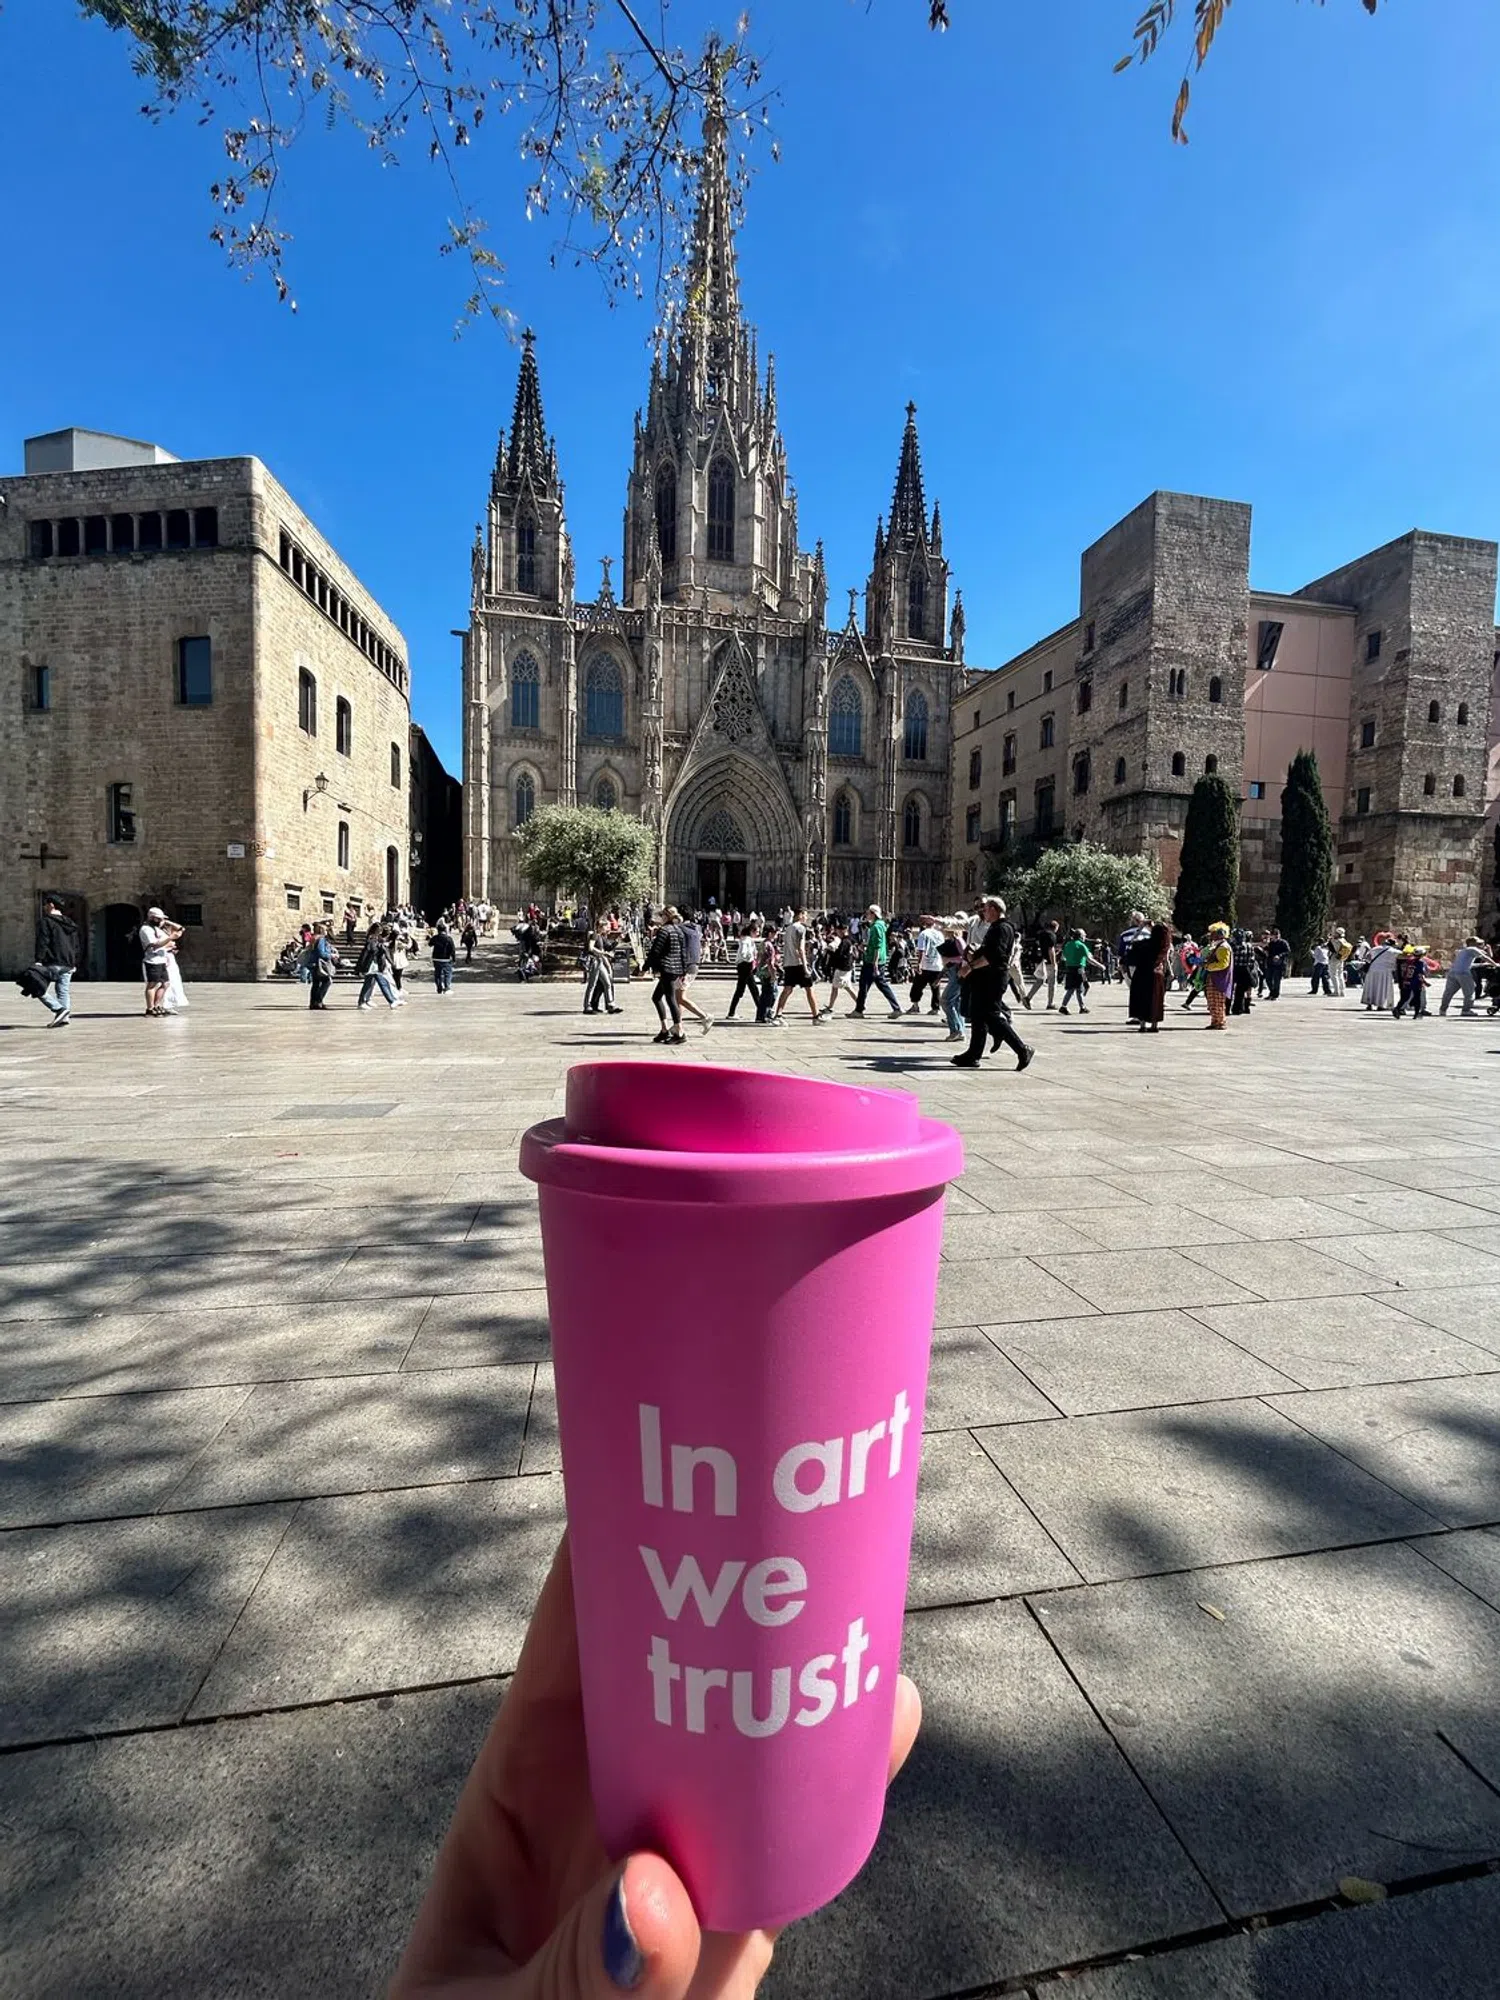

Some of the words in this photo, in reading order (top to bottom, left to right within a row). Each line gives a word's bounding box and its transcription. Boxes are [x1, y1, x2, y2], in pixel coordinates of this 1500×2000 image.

[638, 1403, 737, 1516] In
[773, 1389, 911, 1513] art
[638, 1545, 808, 1627] we
[647, 1616, 880, 1738] trust.
